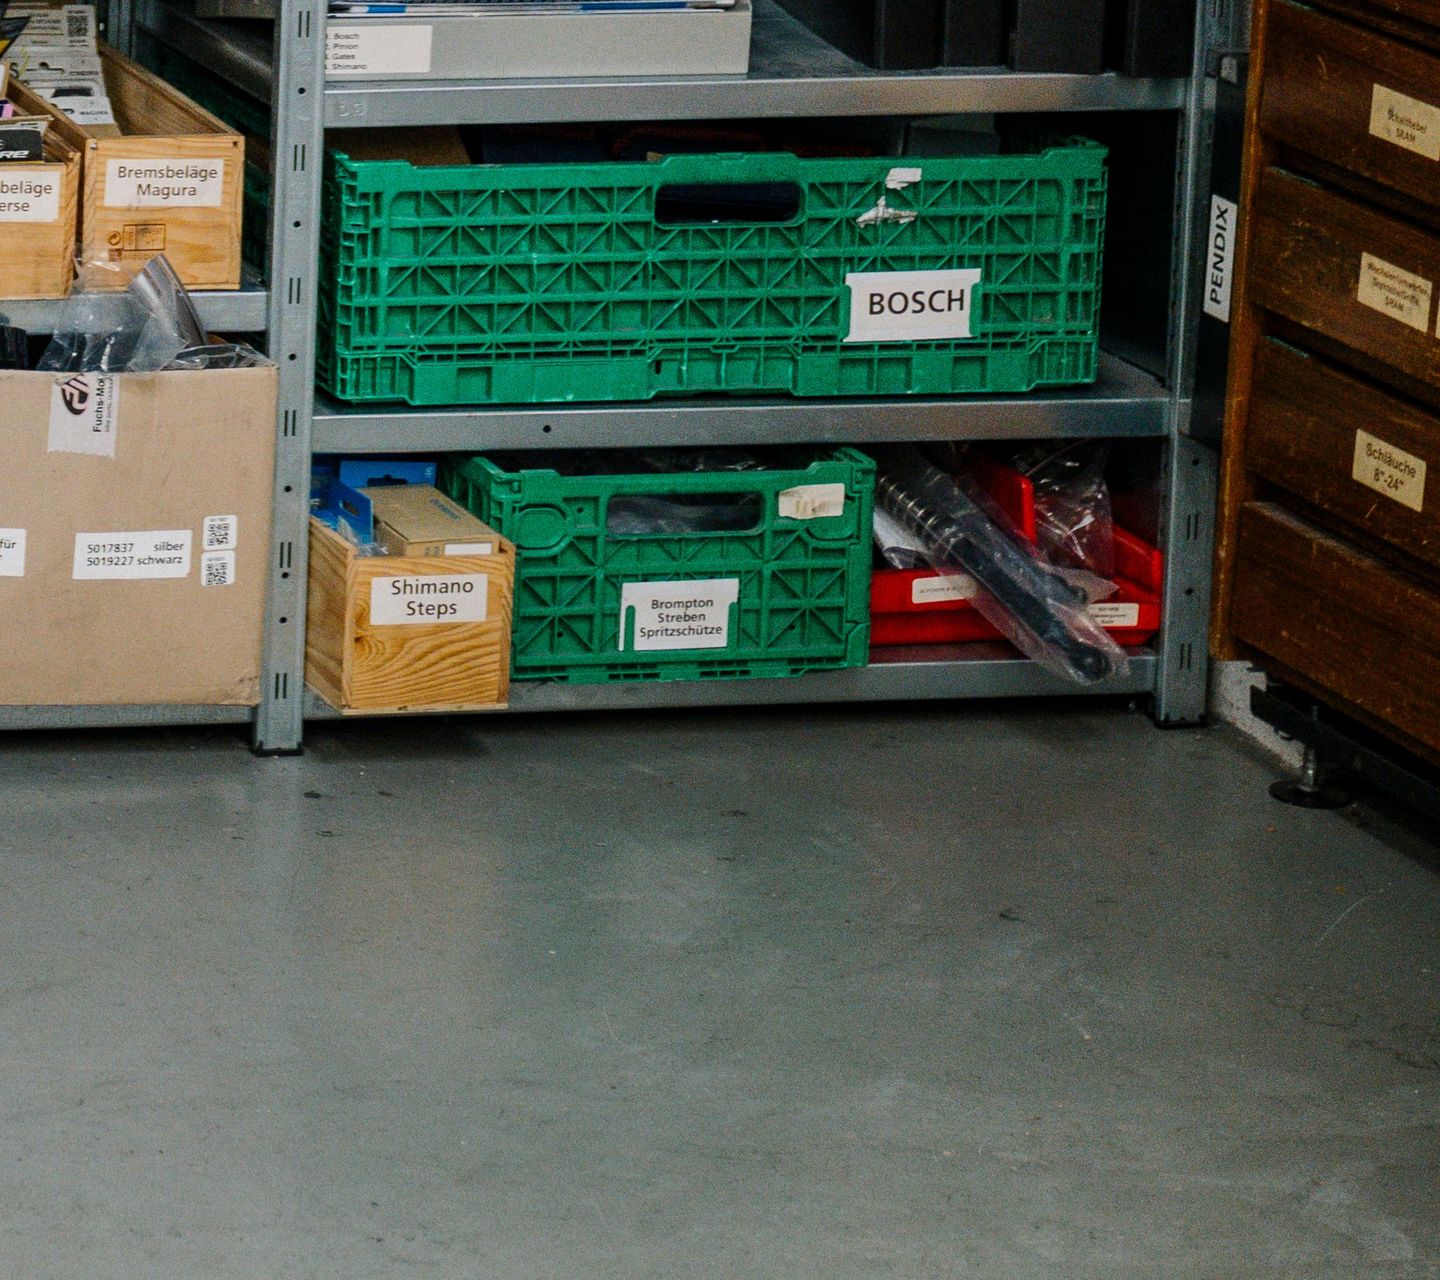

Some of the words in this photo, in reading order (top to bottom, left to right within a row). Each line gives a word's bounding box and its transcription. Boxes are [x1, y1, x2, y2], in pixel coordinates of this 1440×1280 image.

[333, 32, 360, 40] Bosch
[333, 42, 359, 50] Pinion
[117, 165, 218, 181] Bremsbeläge
[136, 183, 198, 199] Magura
[1210, 204, 1229, 305] PENDIX
[868, 289, 965, 316] BOSCH
[1365, 442, 1417, 479] Schläuche
[0, 538, 16, 550] für
[87, 542, 134, 554] 5017837
[153, 541, 184, 552] silber
[86, 555, 133, 567] 5019227
[137, 555, 183, 566] schwarz
[391, 579, 475, 596] Shimano
[406, 600, 458, 619] Steps
[651, 596, 714, 613] Brompton
[657, 610, 706, 624] Streben
[638, 623, 723, 639] Spritzschütze
